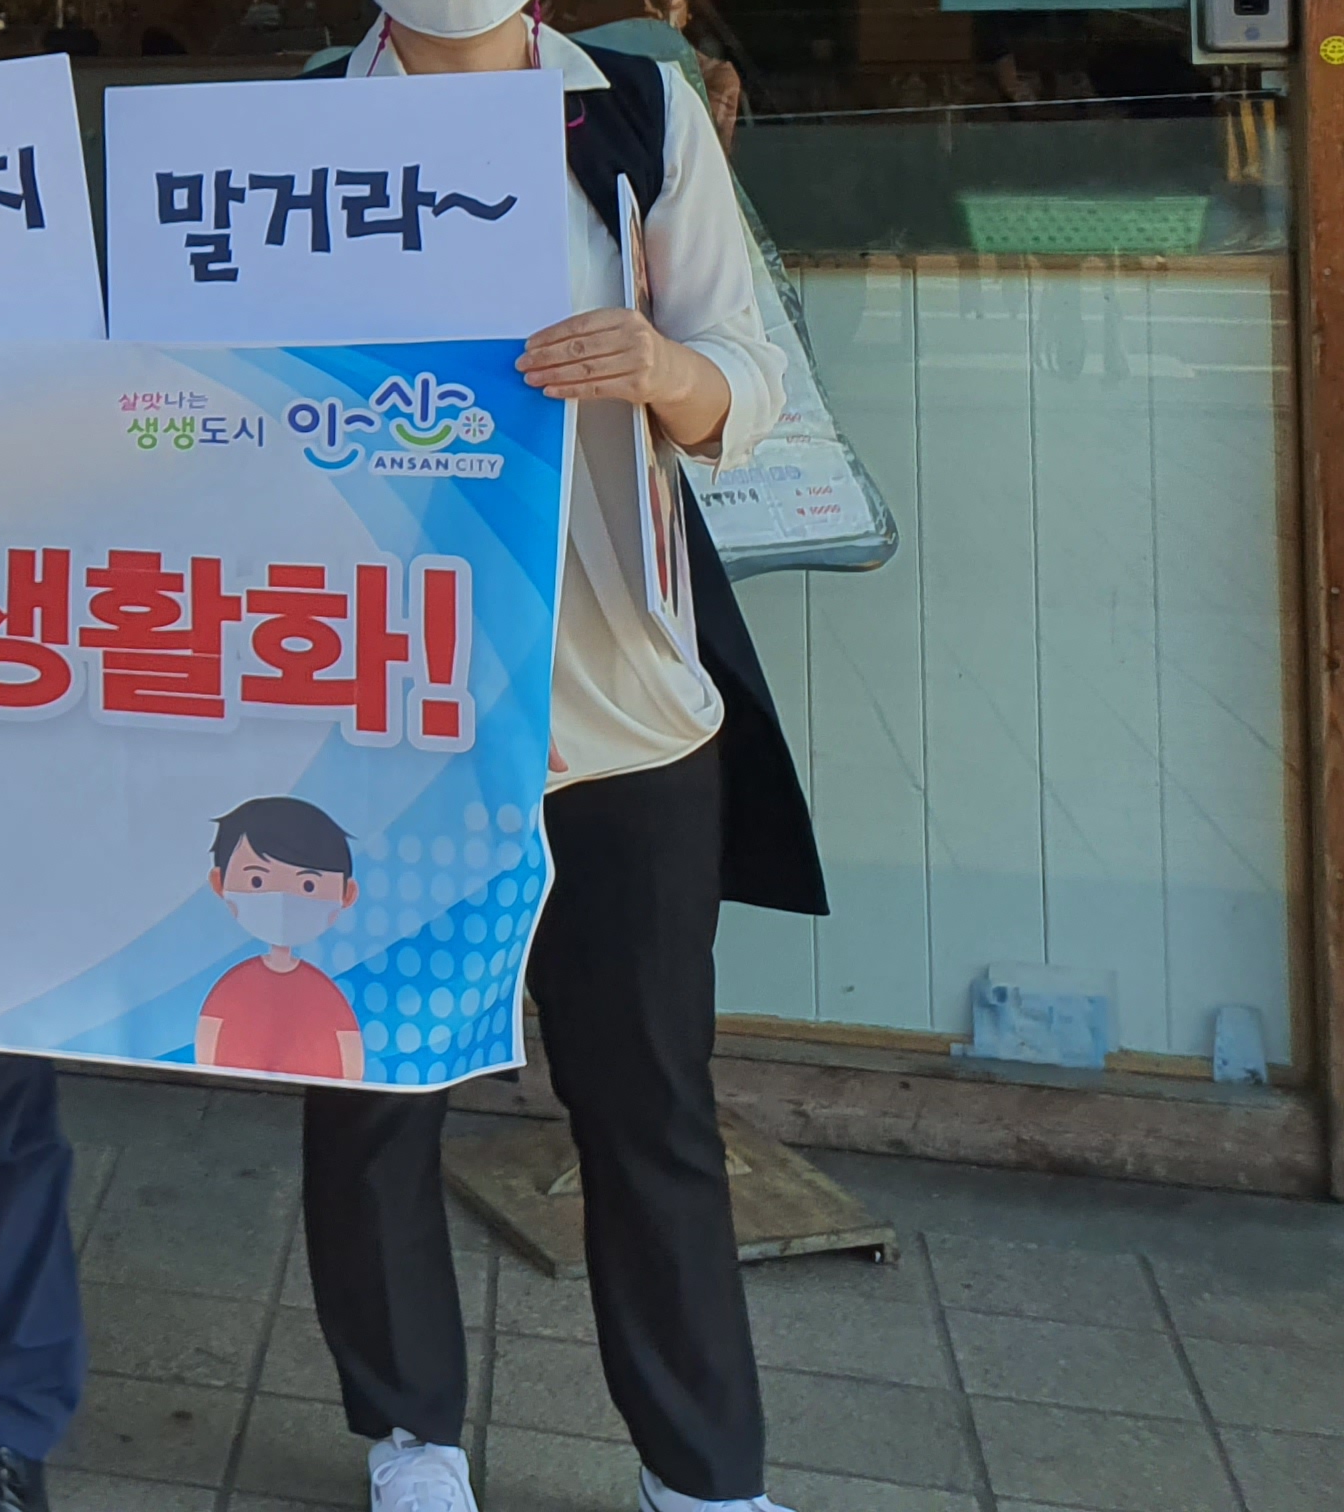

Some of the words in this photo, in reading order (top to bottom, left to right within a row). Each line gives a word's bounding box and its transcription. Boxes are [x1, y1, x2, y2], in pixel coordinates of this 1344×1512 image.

[156, 165, 518, 282] 말거라~
[118, 392, 208, 411] 살맛나는
[127, 415, 265, 450] 생생도시
[374, 455, 450, 472] ANSAN
[455, 457, 499, 474] CITY
